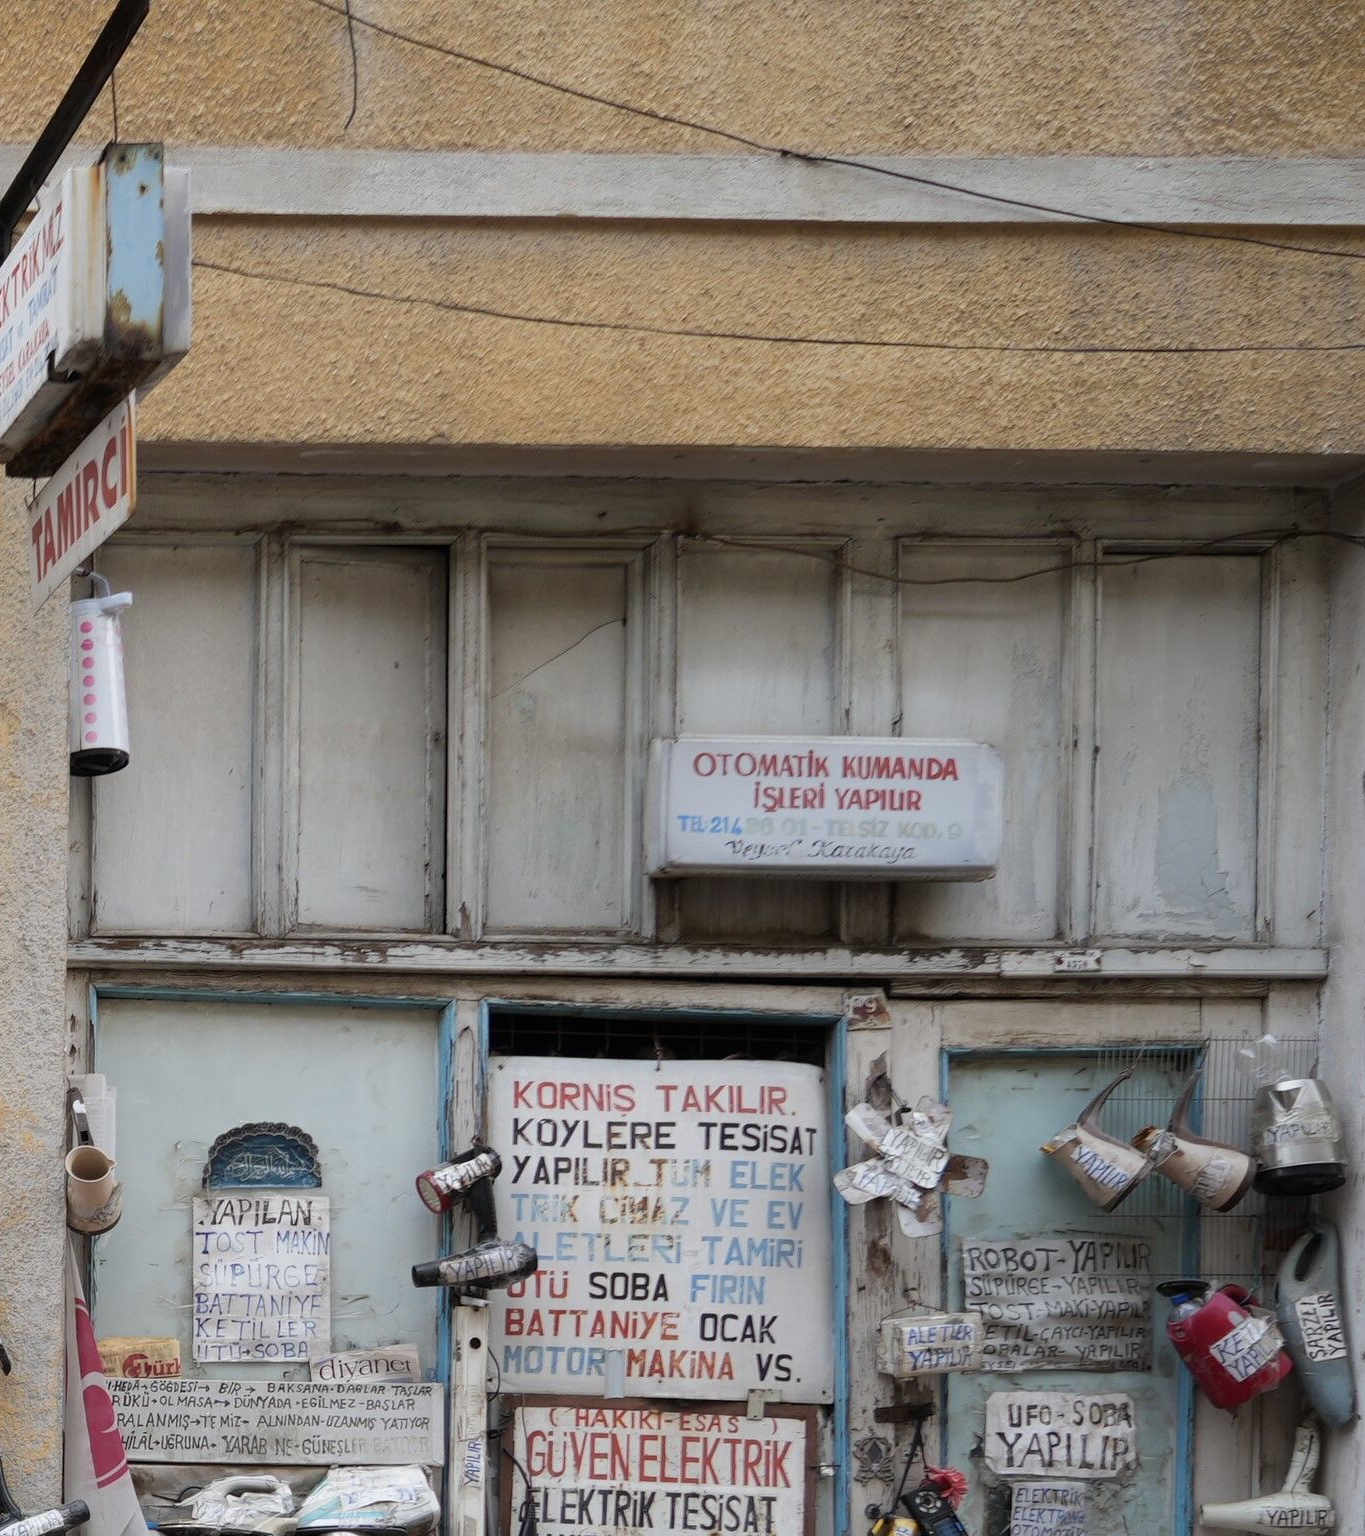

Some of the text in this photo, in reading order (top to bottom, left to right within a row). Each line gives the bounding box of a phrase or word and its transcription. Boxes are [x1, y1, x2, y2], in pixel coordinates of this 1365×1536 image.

[32, 417, 128, 584] TAMİRCİ
[693, 751, 959, 780] OTOMATİK KUMANDA
[754, 782, 824, 812] İŞLERİ
[513, 1081, 635, 1122] KORNİŞ
[698, 1122, 818, 1156] TESİSAT
[729, 1160, 804, 1192] ELEK
[711, 1200, 752, 1228] VE
[766, 1201, 804, 1230] EV
[197, 1232, 262, 1255] TOST
[700, 1236, 802, 1267] TAMİRİ
[200, 1259, 319, 1288] SÜPÜRGE
[589, 1272, 765, 1305] SOBA FIRIN
[505, 1307, 778, 1343] BATTANİYE OCAK
[255, 1344, 309, 1358] SOBA
[503, 1345, 606, 1376] MOTOR
[626, 1348, 735, 1380] MAKİNA
[319, 1357, 414, 1382] diyanet
[219, 1383, 241, 1394] BİR
[526, 1429, 792, 1487] GÜVEN ELEKTRİK
[519, 1487, 777, 1534] ELEKTRİK TESİSAT
[1266, 1509, 1327, 1524] YAPILIR
